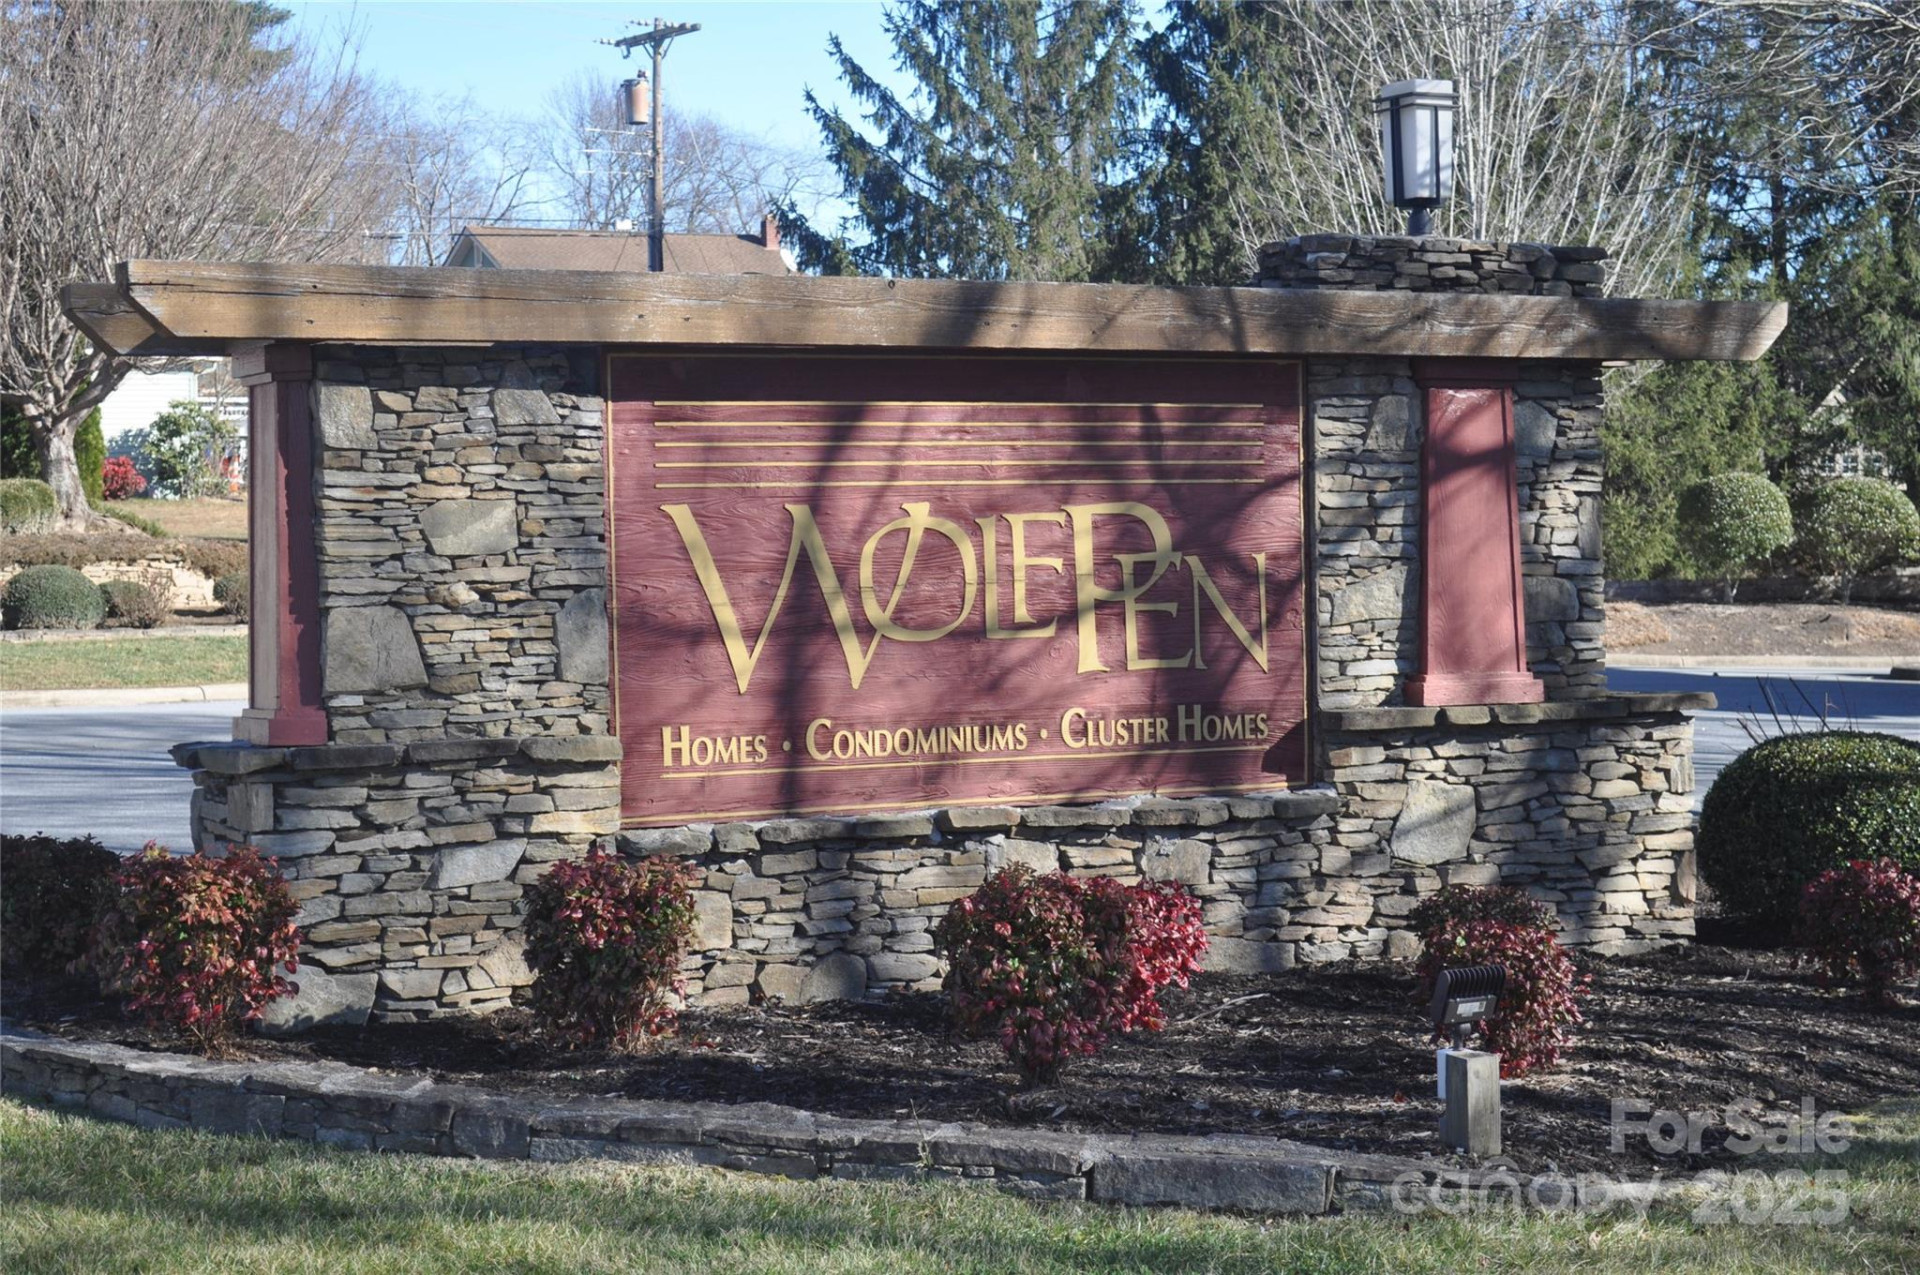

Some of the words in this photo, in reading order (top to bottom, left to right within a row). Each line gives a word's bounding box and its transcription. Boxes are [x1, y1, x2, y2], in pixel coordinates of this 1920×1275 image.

[661, 724, 768, 767] HOMES
[805, 718, 1027, 761] CONDOMINIUMS
[1061, 707, 1169, 749] CLUSTER
[1177, 704, 1269, 742] HOMES
